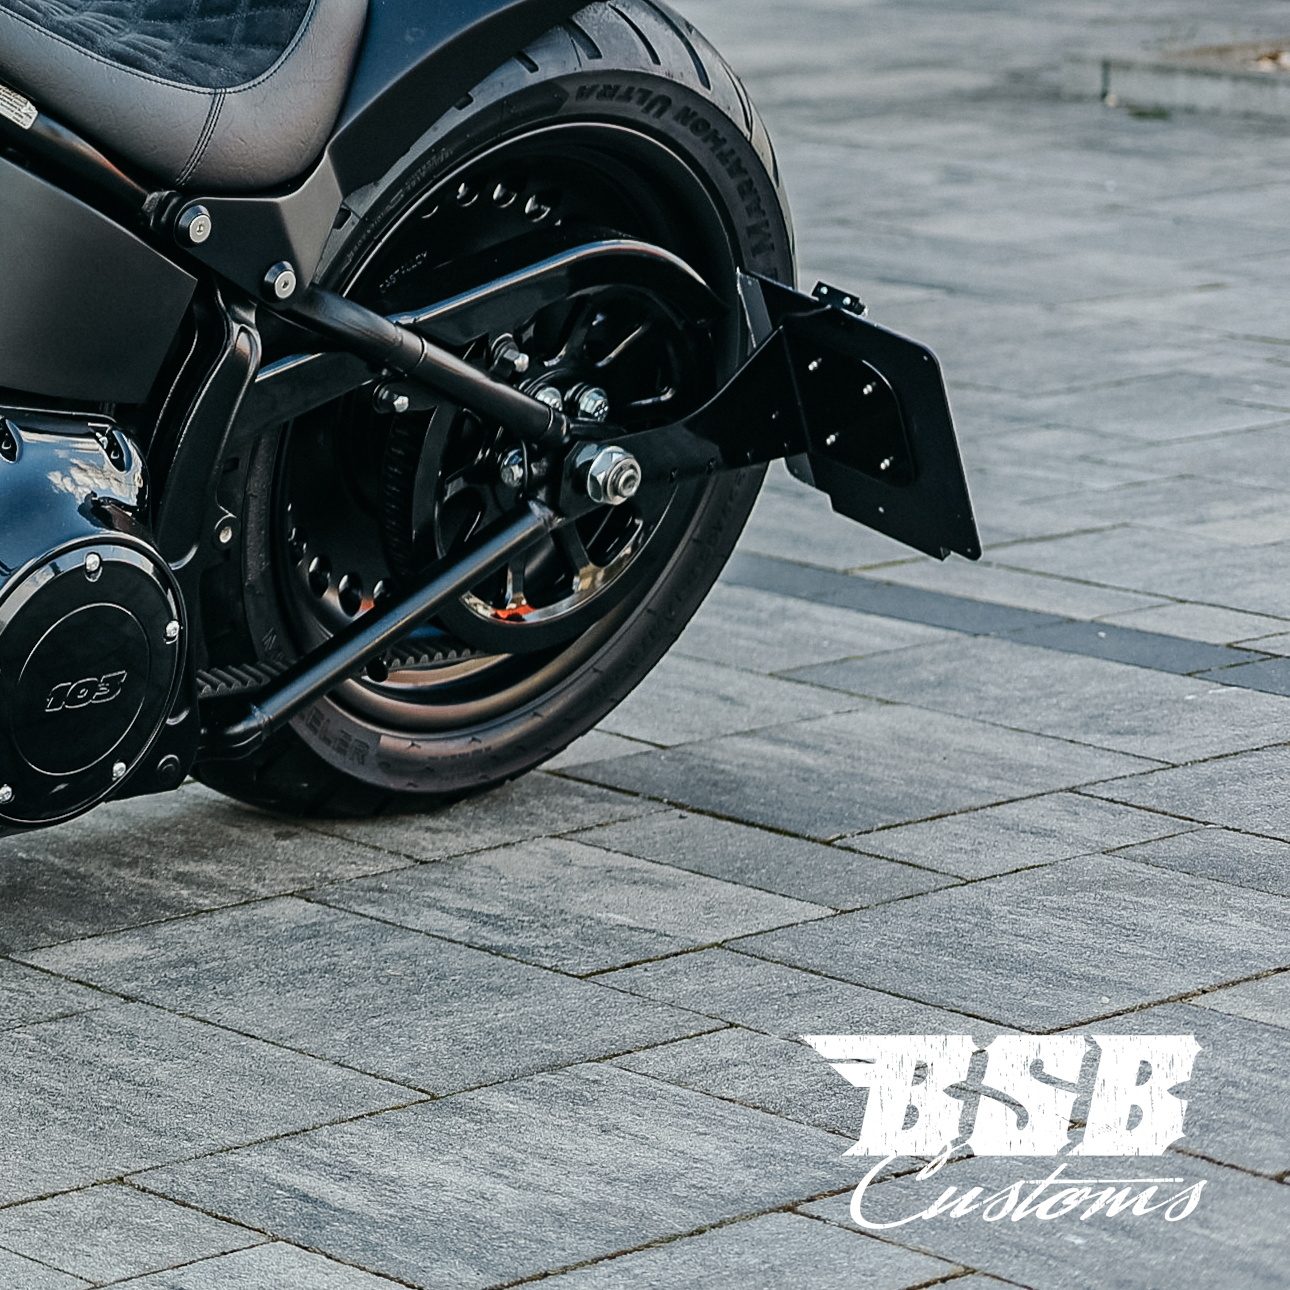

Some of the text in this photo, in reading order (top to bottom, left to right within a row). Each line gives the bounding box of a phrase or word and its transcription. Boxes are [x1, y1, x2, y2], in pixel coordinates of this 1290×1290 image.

[574, 83, 776, 259] MARATHON ULTRA
[44, 670, 128, 713] 103
[300, 703, 371, 766] ELER
